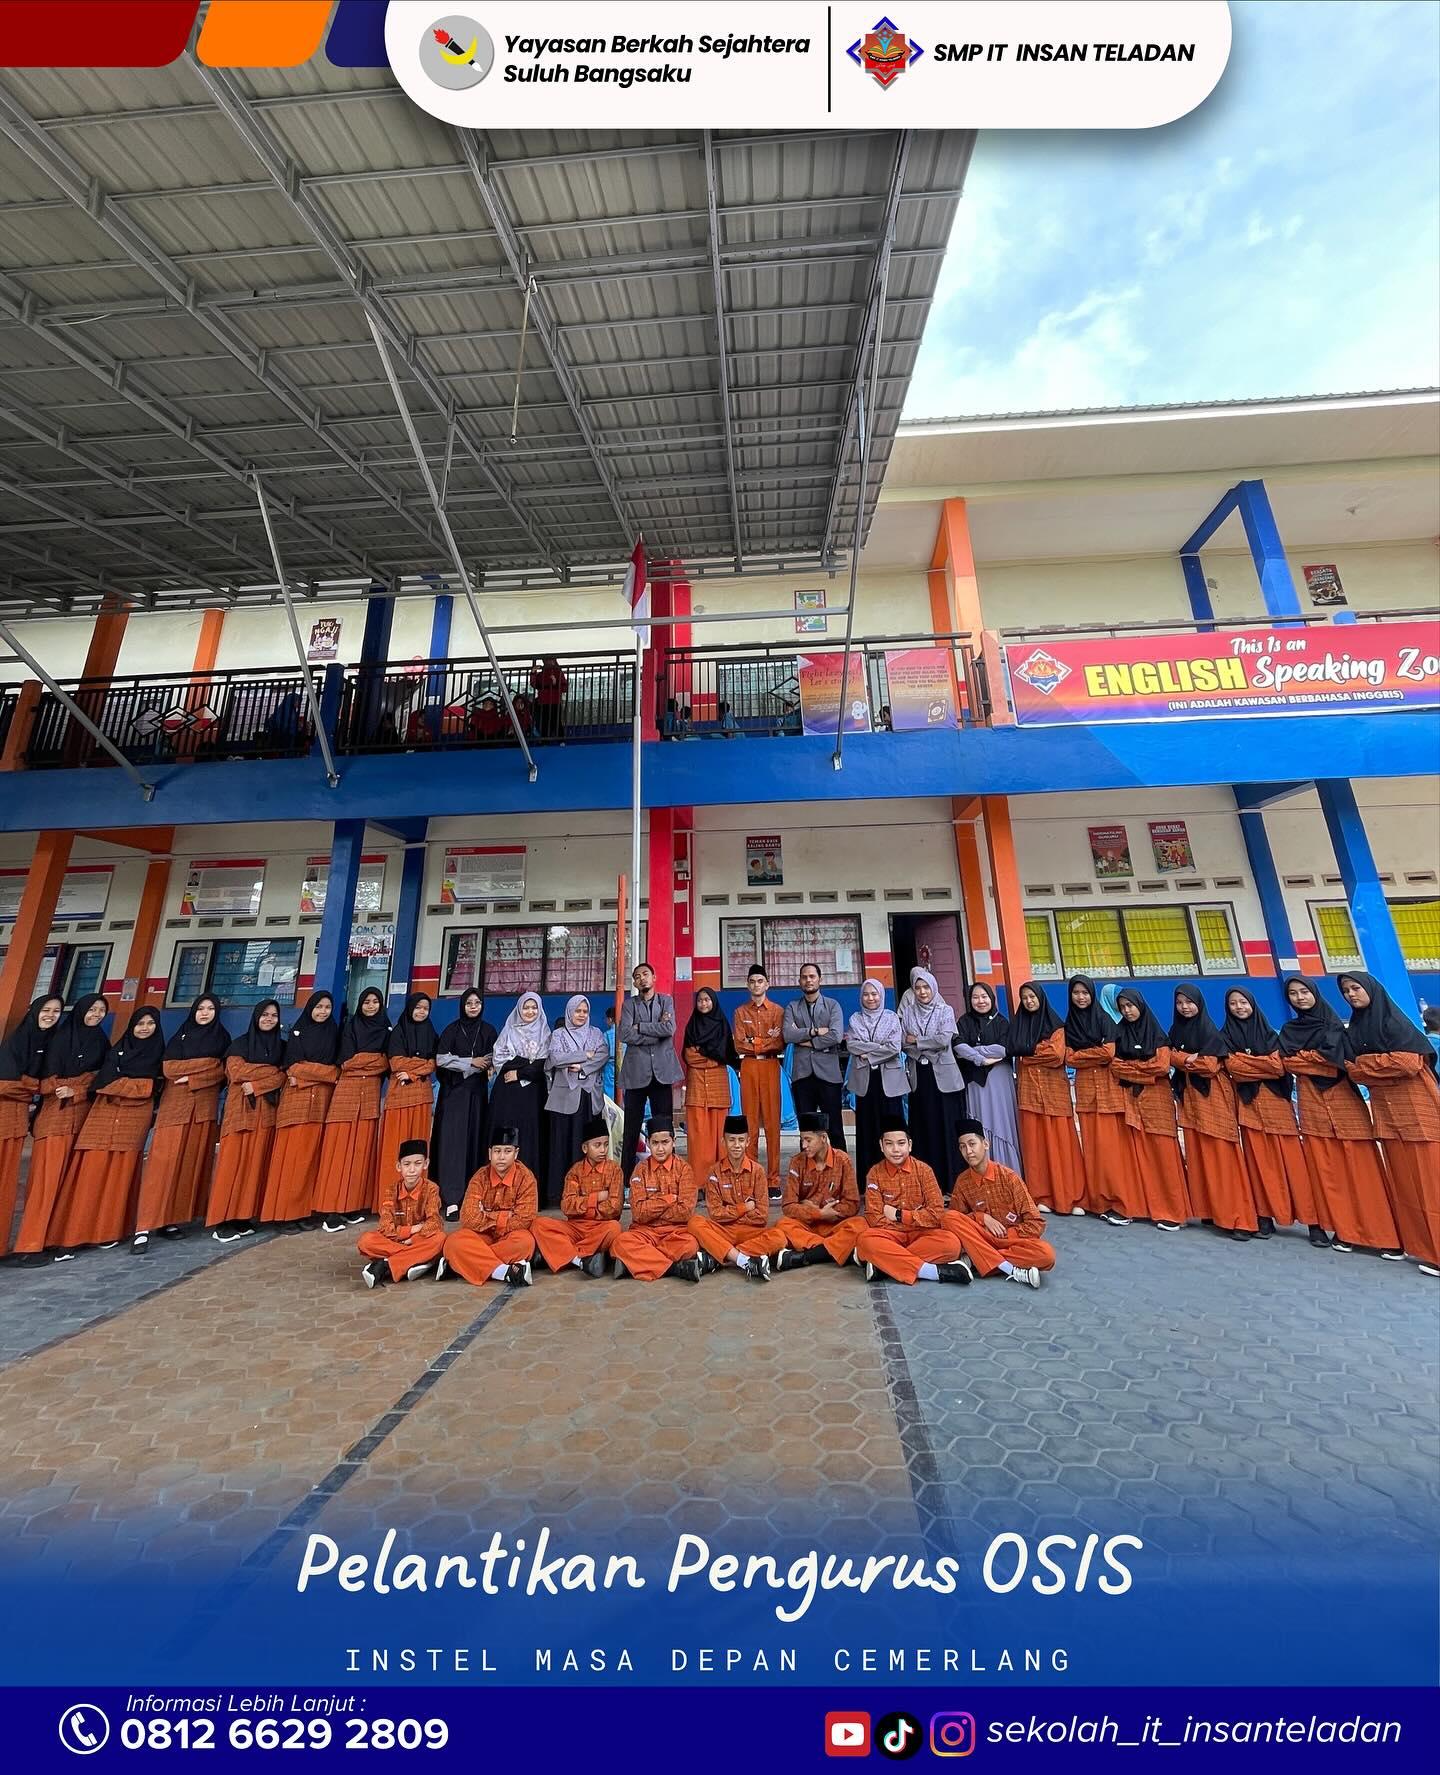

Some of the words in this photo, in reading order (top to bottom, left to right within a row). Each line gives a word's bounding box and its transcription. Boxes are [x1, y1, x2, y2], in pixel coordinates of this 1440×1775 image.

[1230, 636, 1263, 655] This
[1286, 638, 1307, 652] an
[1083, 656, 1249, 696] ENGLISH
[1251, 652, 1386, 692] Speaking
[1396, 647, 1440, 681] Zo
[1190, 698, 1232, 710] ADALAH
[1233, 695, 1288, 707] KAWASAN
[1289, 692, 1351, 704] BERBAHASA
[1352, 689, 1404, 701] INGGRIS)
